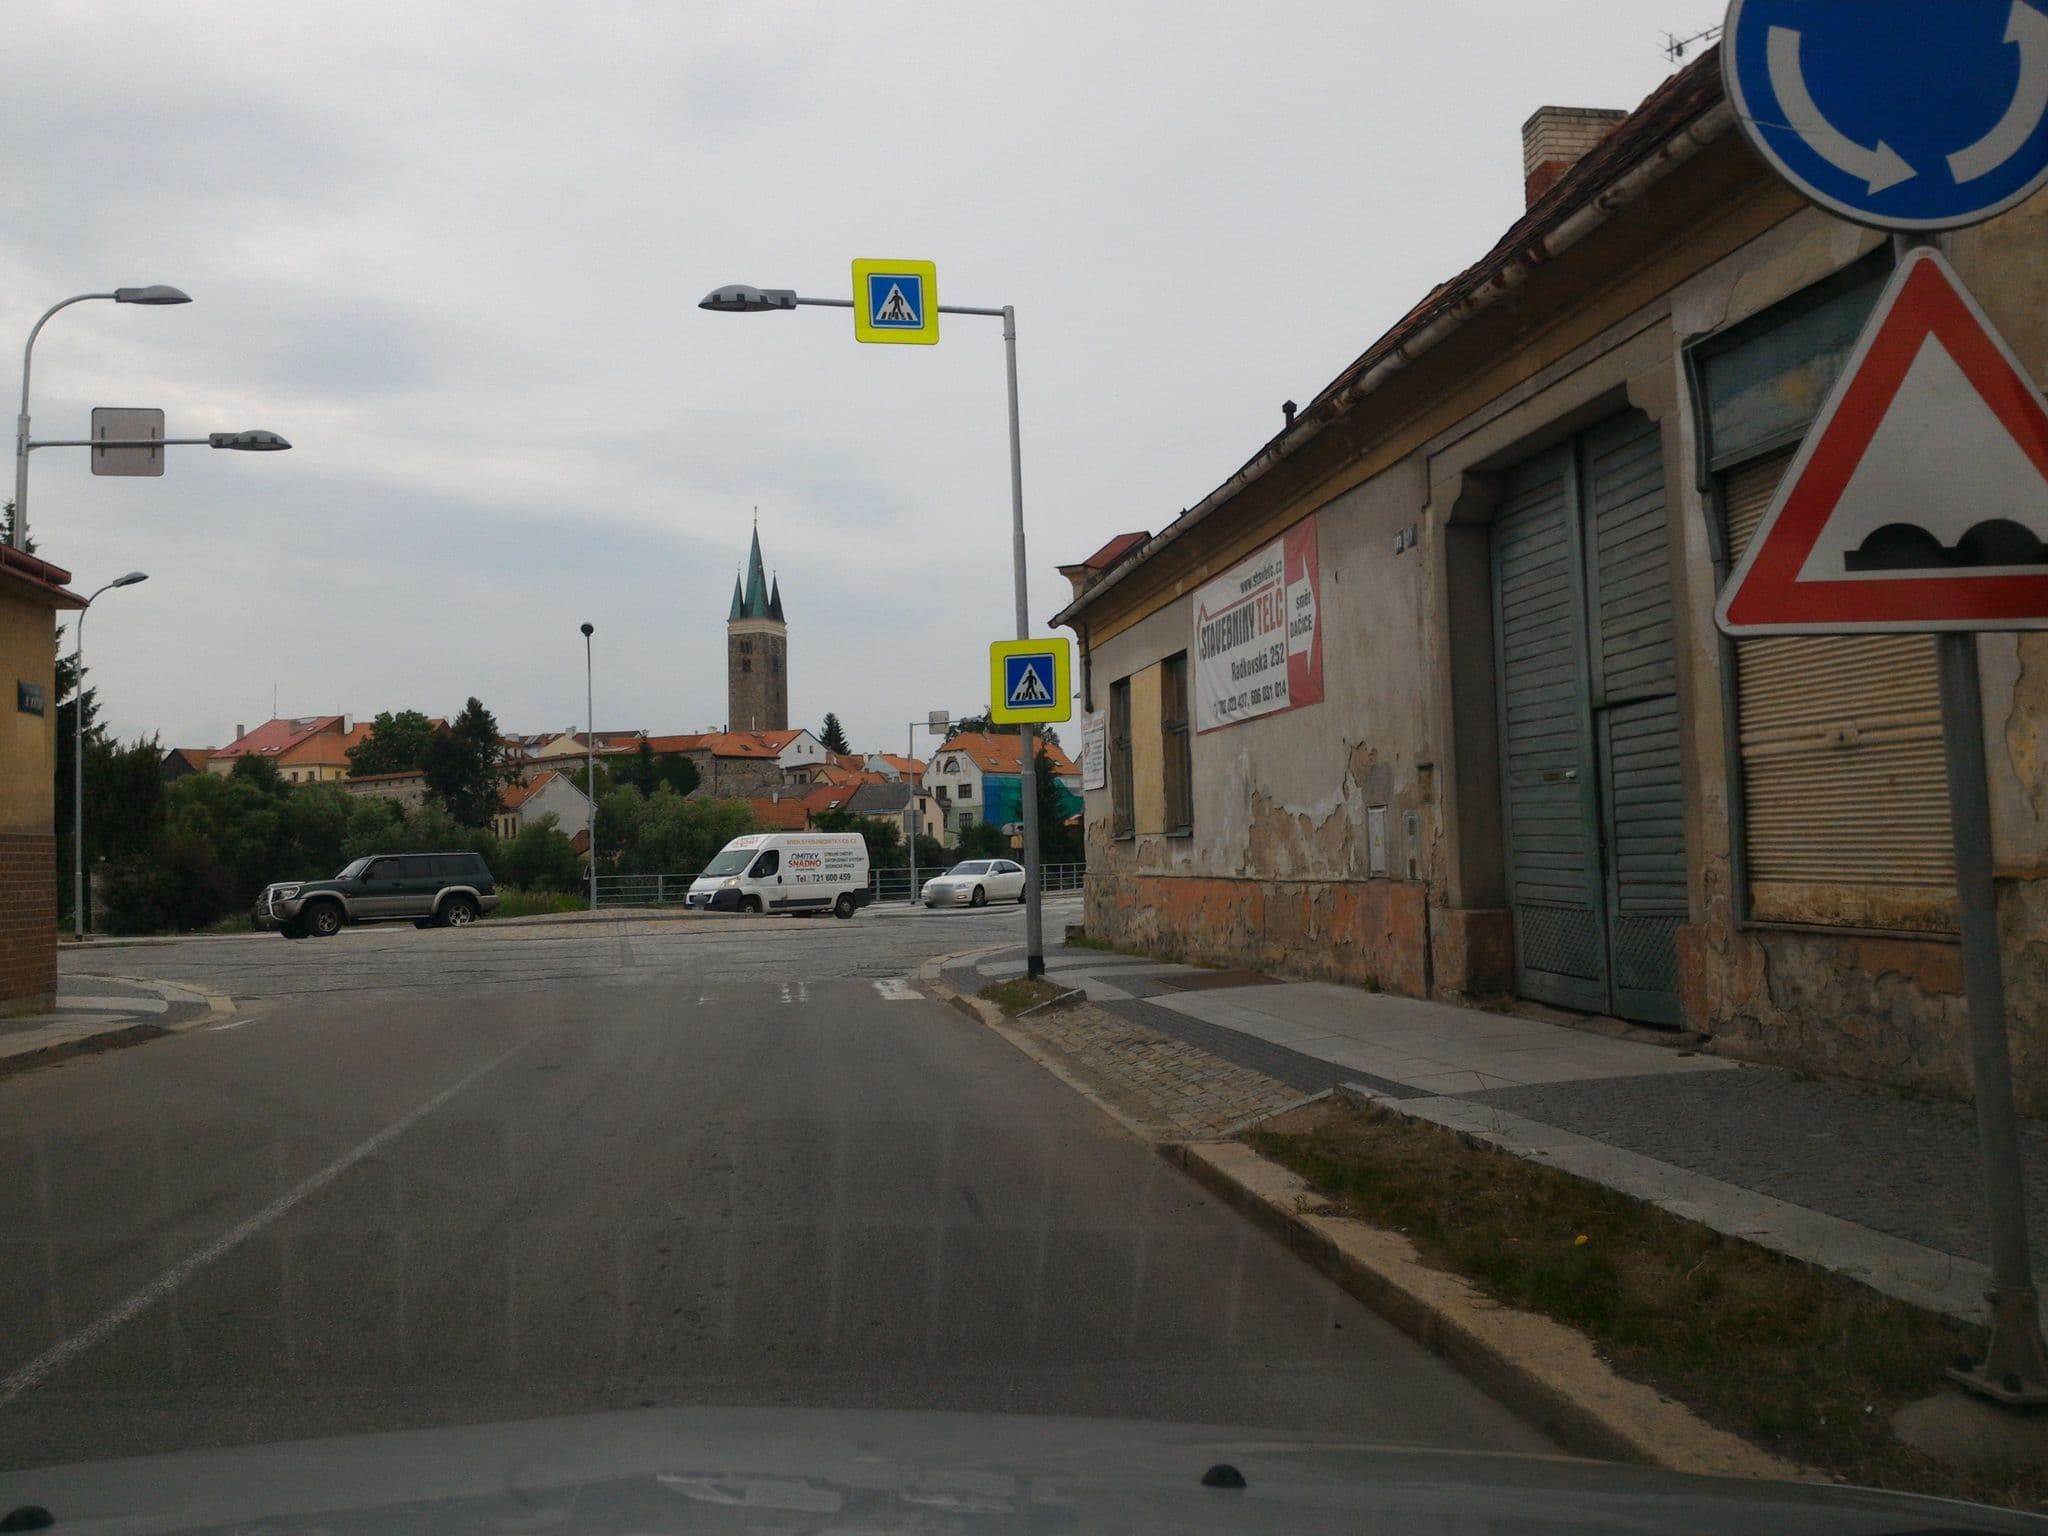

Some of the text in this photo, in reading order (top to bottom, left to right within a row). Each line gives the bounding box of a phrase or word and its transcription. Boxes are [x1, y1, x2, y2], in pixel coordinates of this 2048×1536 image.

[1201, 576, 1284, 661] STAVEBNINY TELČ
[1289, 613, 1312, 638] DAČICE
[1270, 642, 1285, 667] 252
[788, 859, 822, 868] SNADNO
[812, 873, 824, 882] 721
[826, 873, 838, 882] 600
[839, 872, 851, 881] 459
